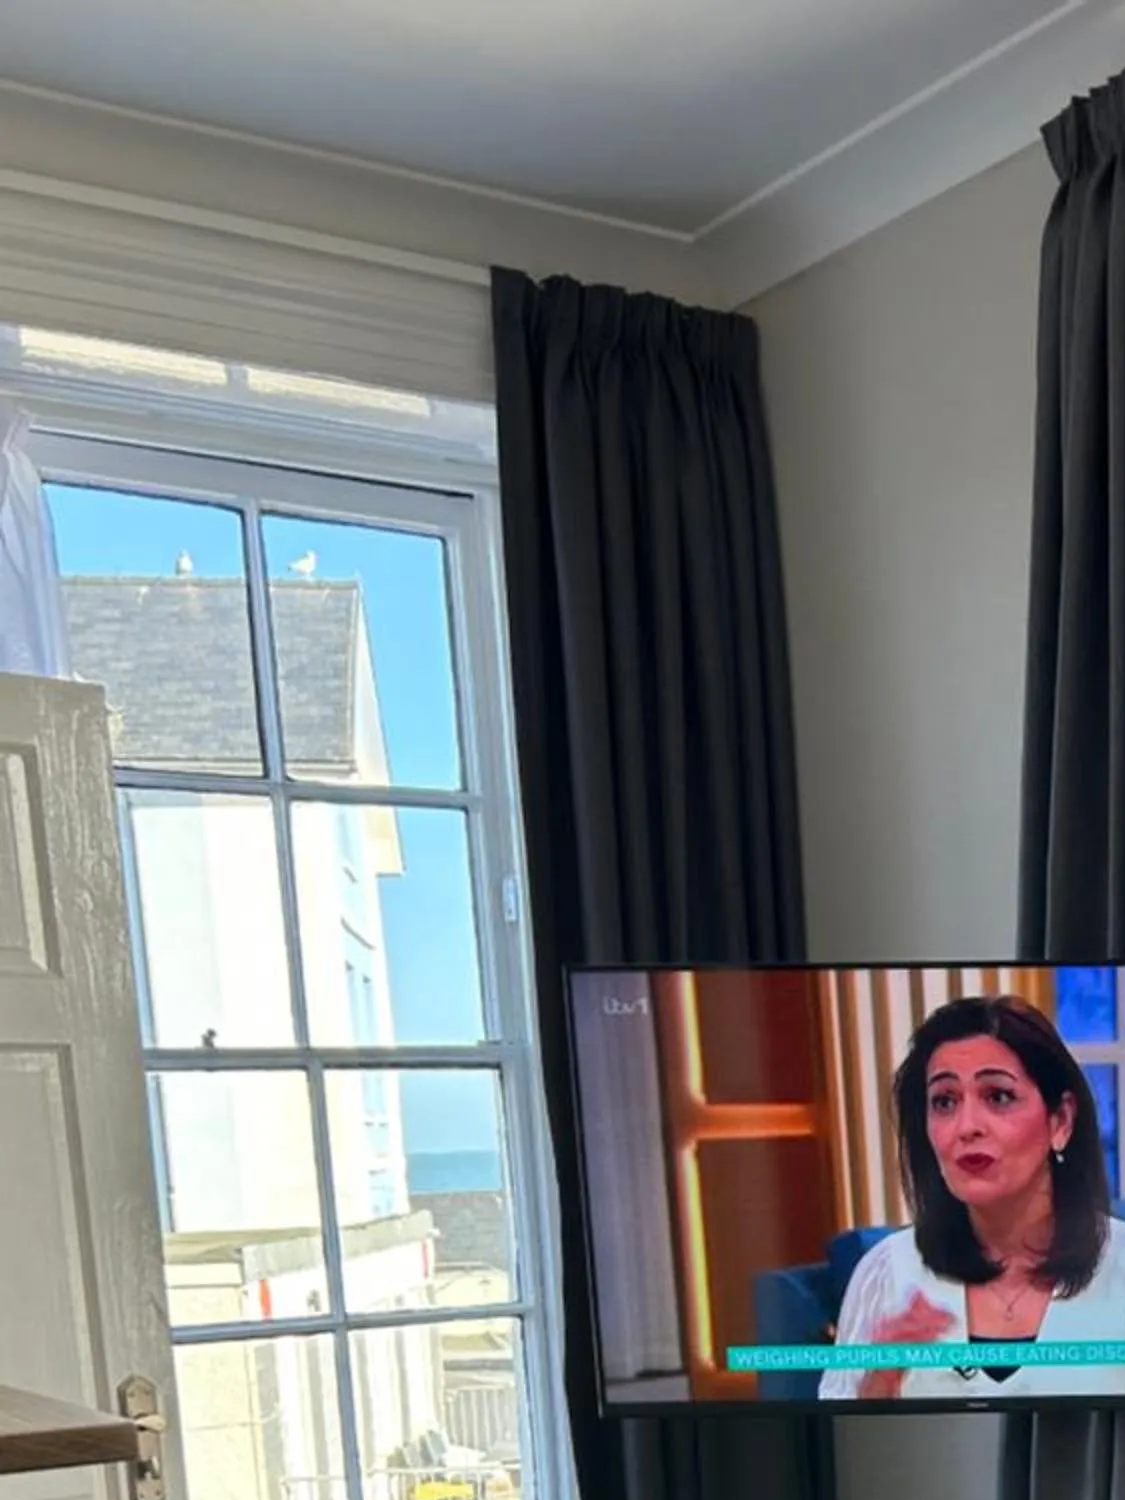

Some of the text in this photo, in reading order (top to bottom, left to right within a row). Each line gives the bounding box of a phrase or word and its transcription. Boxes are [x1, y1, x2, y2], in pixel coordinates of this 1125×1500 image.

[735, 1350, 830, 1366] WEIGHING
[836, 1349, 899, 1364] PUPILS
[905, 1347, 943, 1363] MAY
[949, 1346, 1009, 1362] CAUSE
[1016, 1345, 1080, 1361] EATING
